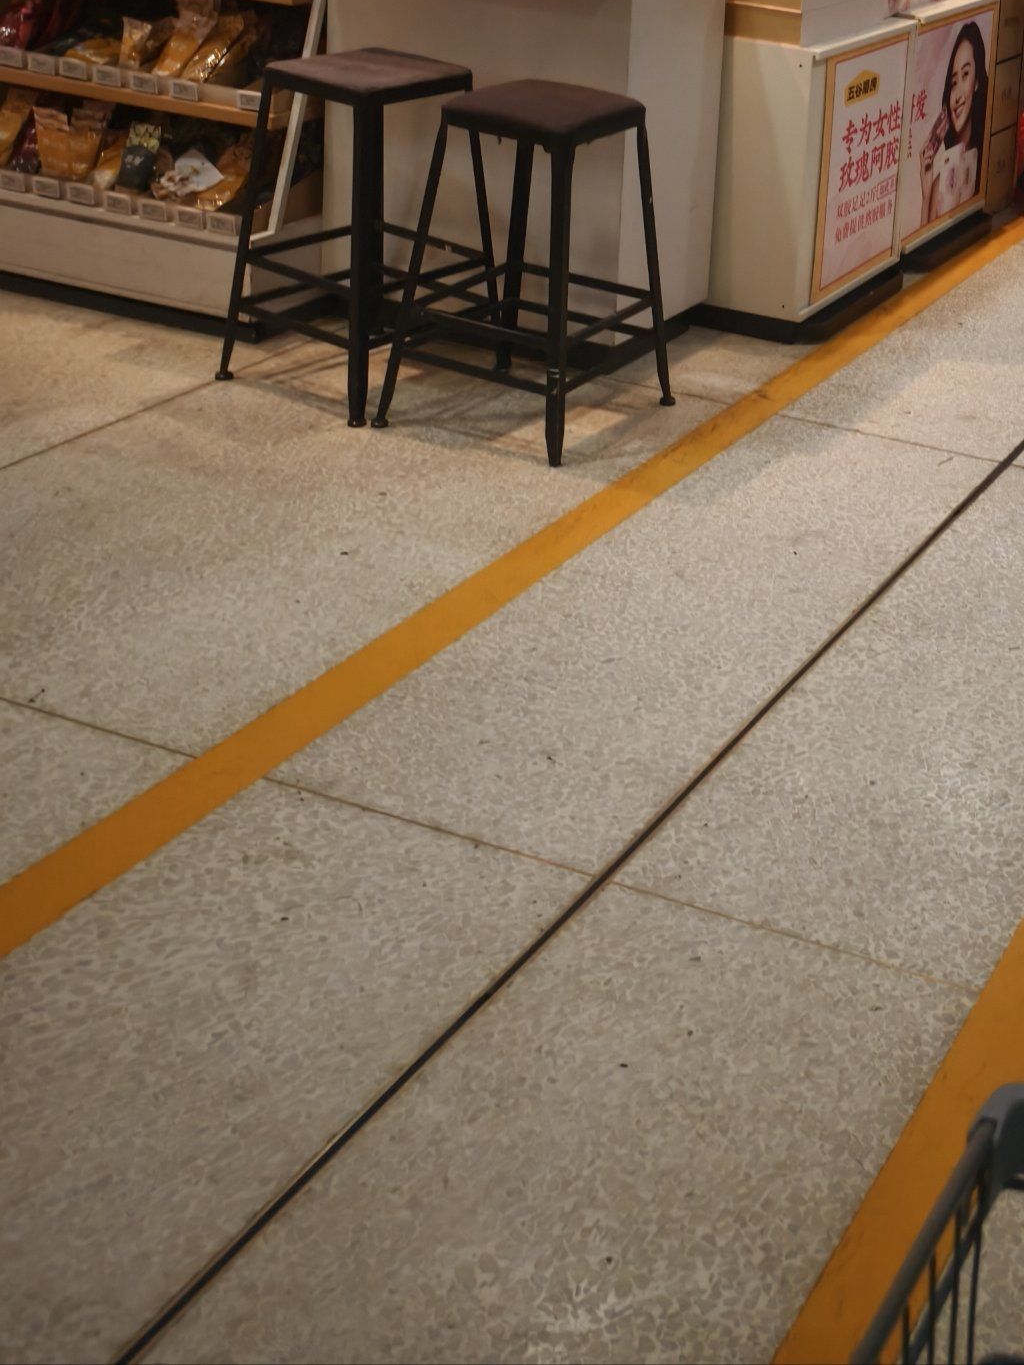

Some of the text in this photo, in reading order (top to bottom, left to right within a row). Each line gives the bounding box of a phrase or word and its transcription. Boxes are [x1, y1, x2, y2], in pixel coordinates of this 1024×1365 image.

[847, 77, 878, 102] 五谷磨房
[842, 100, 901, 155] 专为女性
[838, 136, 899, 193] 玫瑰阿胶
